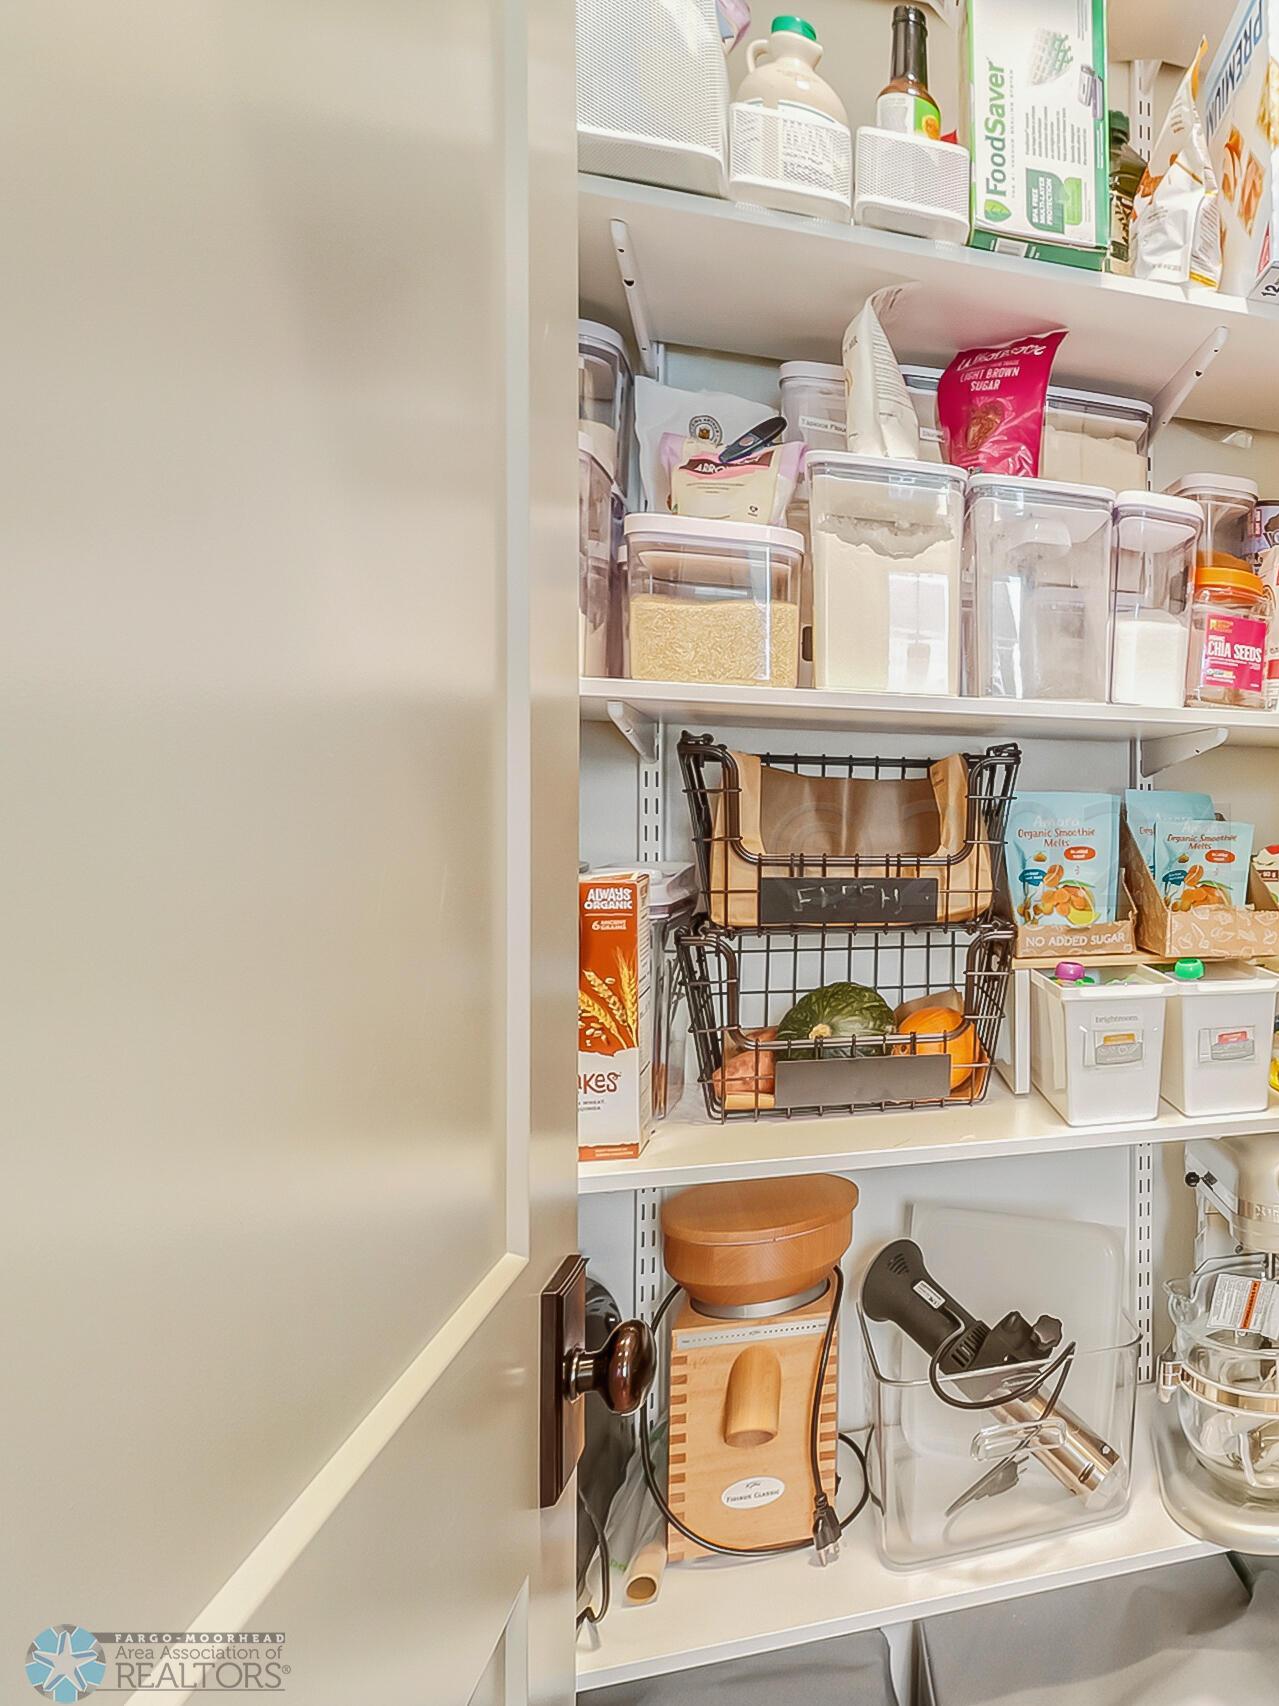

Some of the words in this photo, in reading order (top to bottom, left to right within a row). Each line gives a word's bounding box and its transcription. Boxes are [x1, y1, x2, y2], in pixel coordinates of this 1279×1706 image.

[983, 59, 1007, 196] FoodSaver
[1046, 176, 1054, 225] PROTECTION
[985, 366, 1021, 379] BROWN
[970, 380, 1001, 391] SUGAR
[1208, 641, 1232, 658] CHIA
[1233, 643, 1262, 663] SEEDS
[1018, 828, 1051, 840] Organic
[1054, 826, 1096, 837] Smoothie
[1167, 833, 1198, 843] Organic
[1200, 833, 1238, 842] Smoothie
[1043, 838, 1071, 848] Melts
[1188, 842, 1213, 850] Melts
[587, 887, 633, 901] ALWAYS
[584, 900, 633, 910] ORGANIC
[591, 920, 601, 930] 6
[1025, 936, 1045, 947] NO
[1048, 934, 1088, 946] ADDED
[1090, 932, 1126, 944] SUGAR
[1095, 1013, 1139, 1024] brightroom
